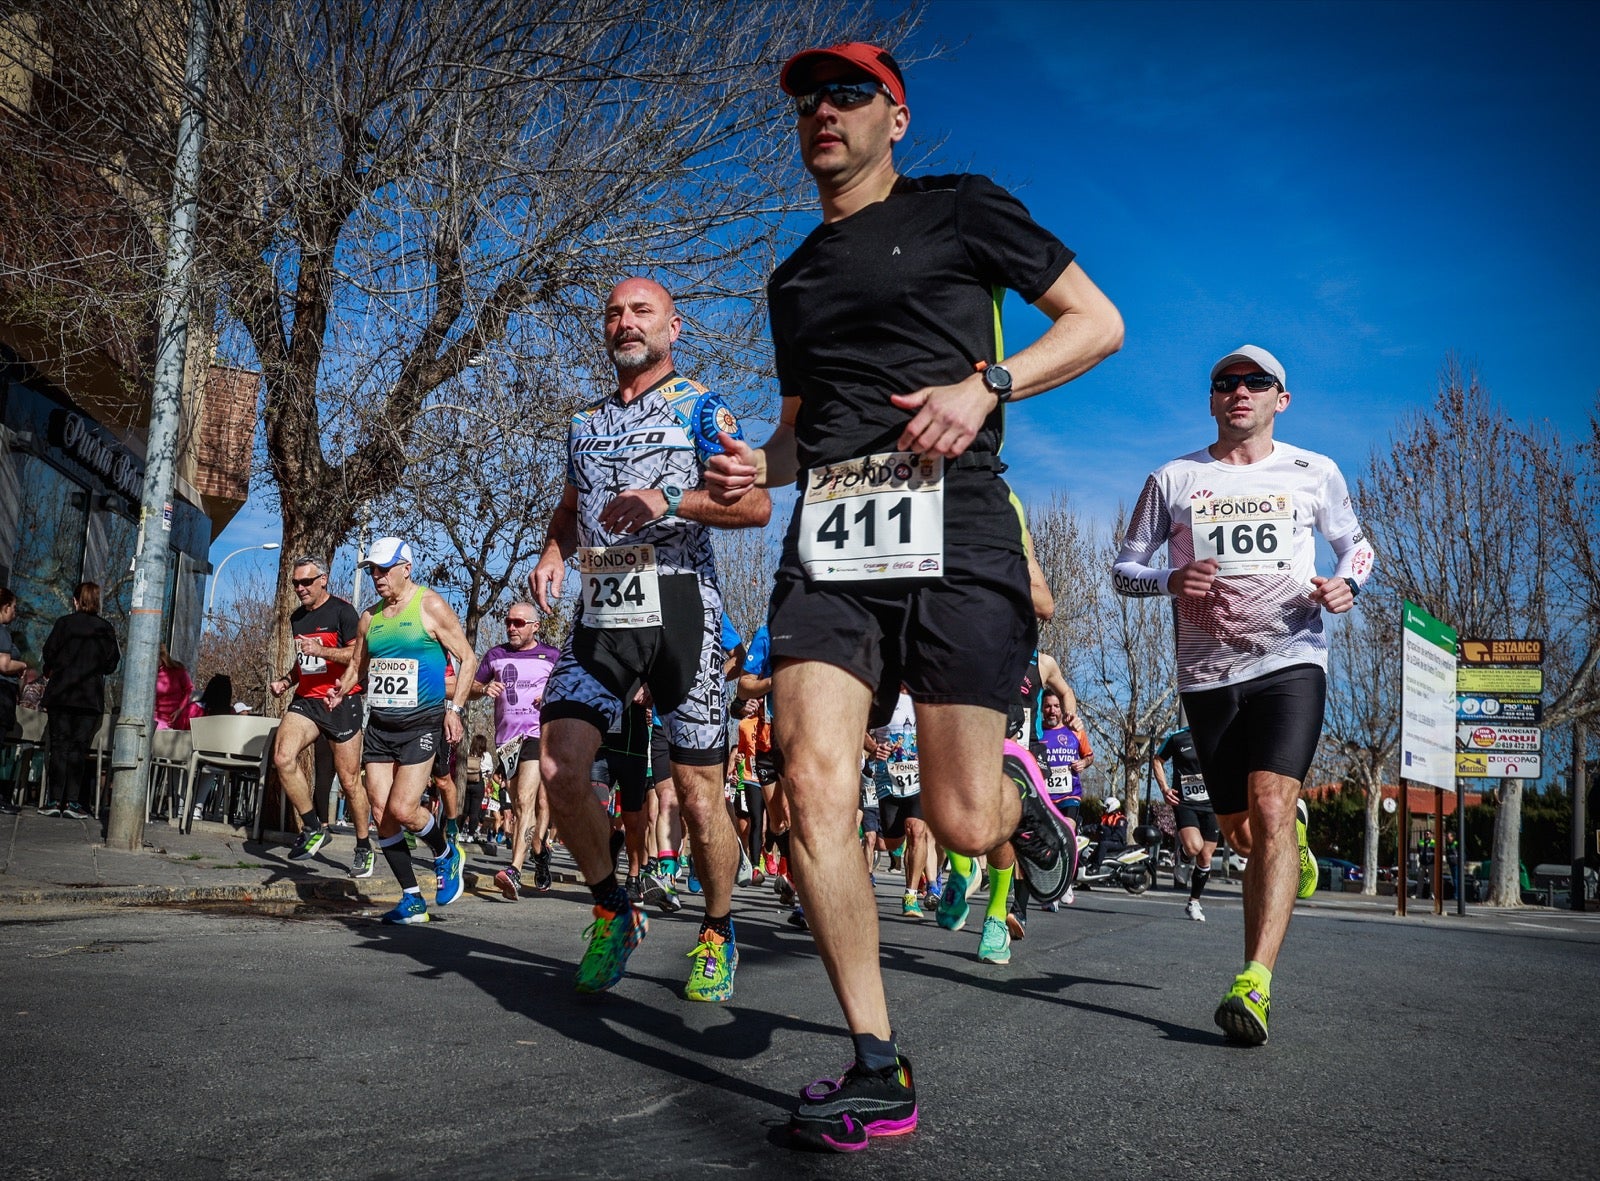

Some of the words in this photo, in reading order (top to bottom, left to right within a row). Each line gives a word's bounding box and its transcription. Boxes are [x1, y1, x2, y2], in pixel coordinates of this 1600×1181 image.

[1212, 501, 1272, 516] FONDO
[816, 496, 912, 549] 411
[1208, 523, 1278, 556] 166
[587, 552, 637, 567] FONDO
[1114, 569, 1160, 593] ÓRGIVA
[589, 575, 646, 608] 234
[1492, 641, 1541, 653] ESTANCO
[373, 676, 409, 695] 262
[1497, 756, 1538, 764] DECOPAQ
[1051, 767, 1067, 775] ONDO
[896, 774, 920, 788] 812
[1047, 776, 1069, 788] 821
[1184, 784, 1206, 796] 309
